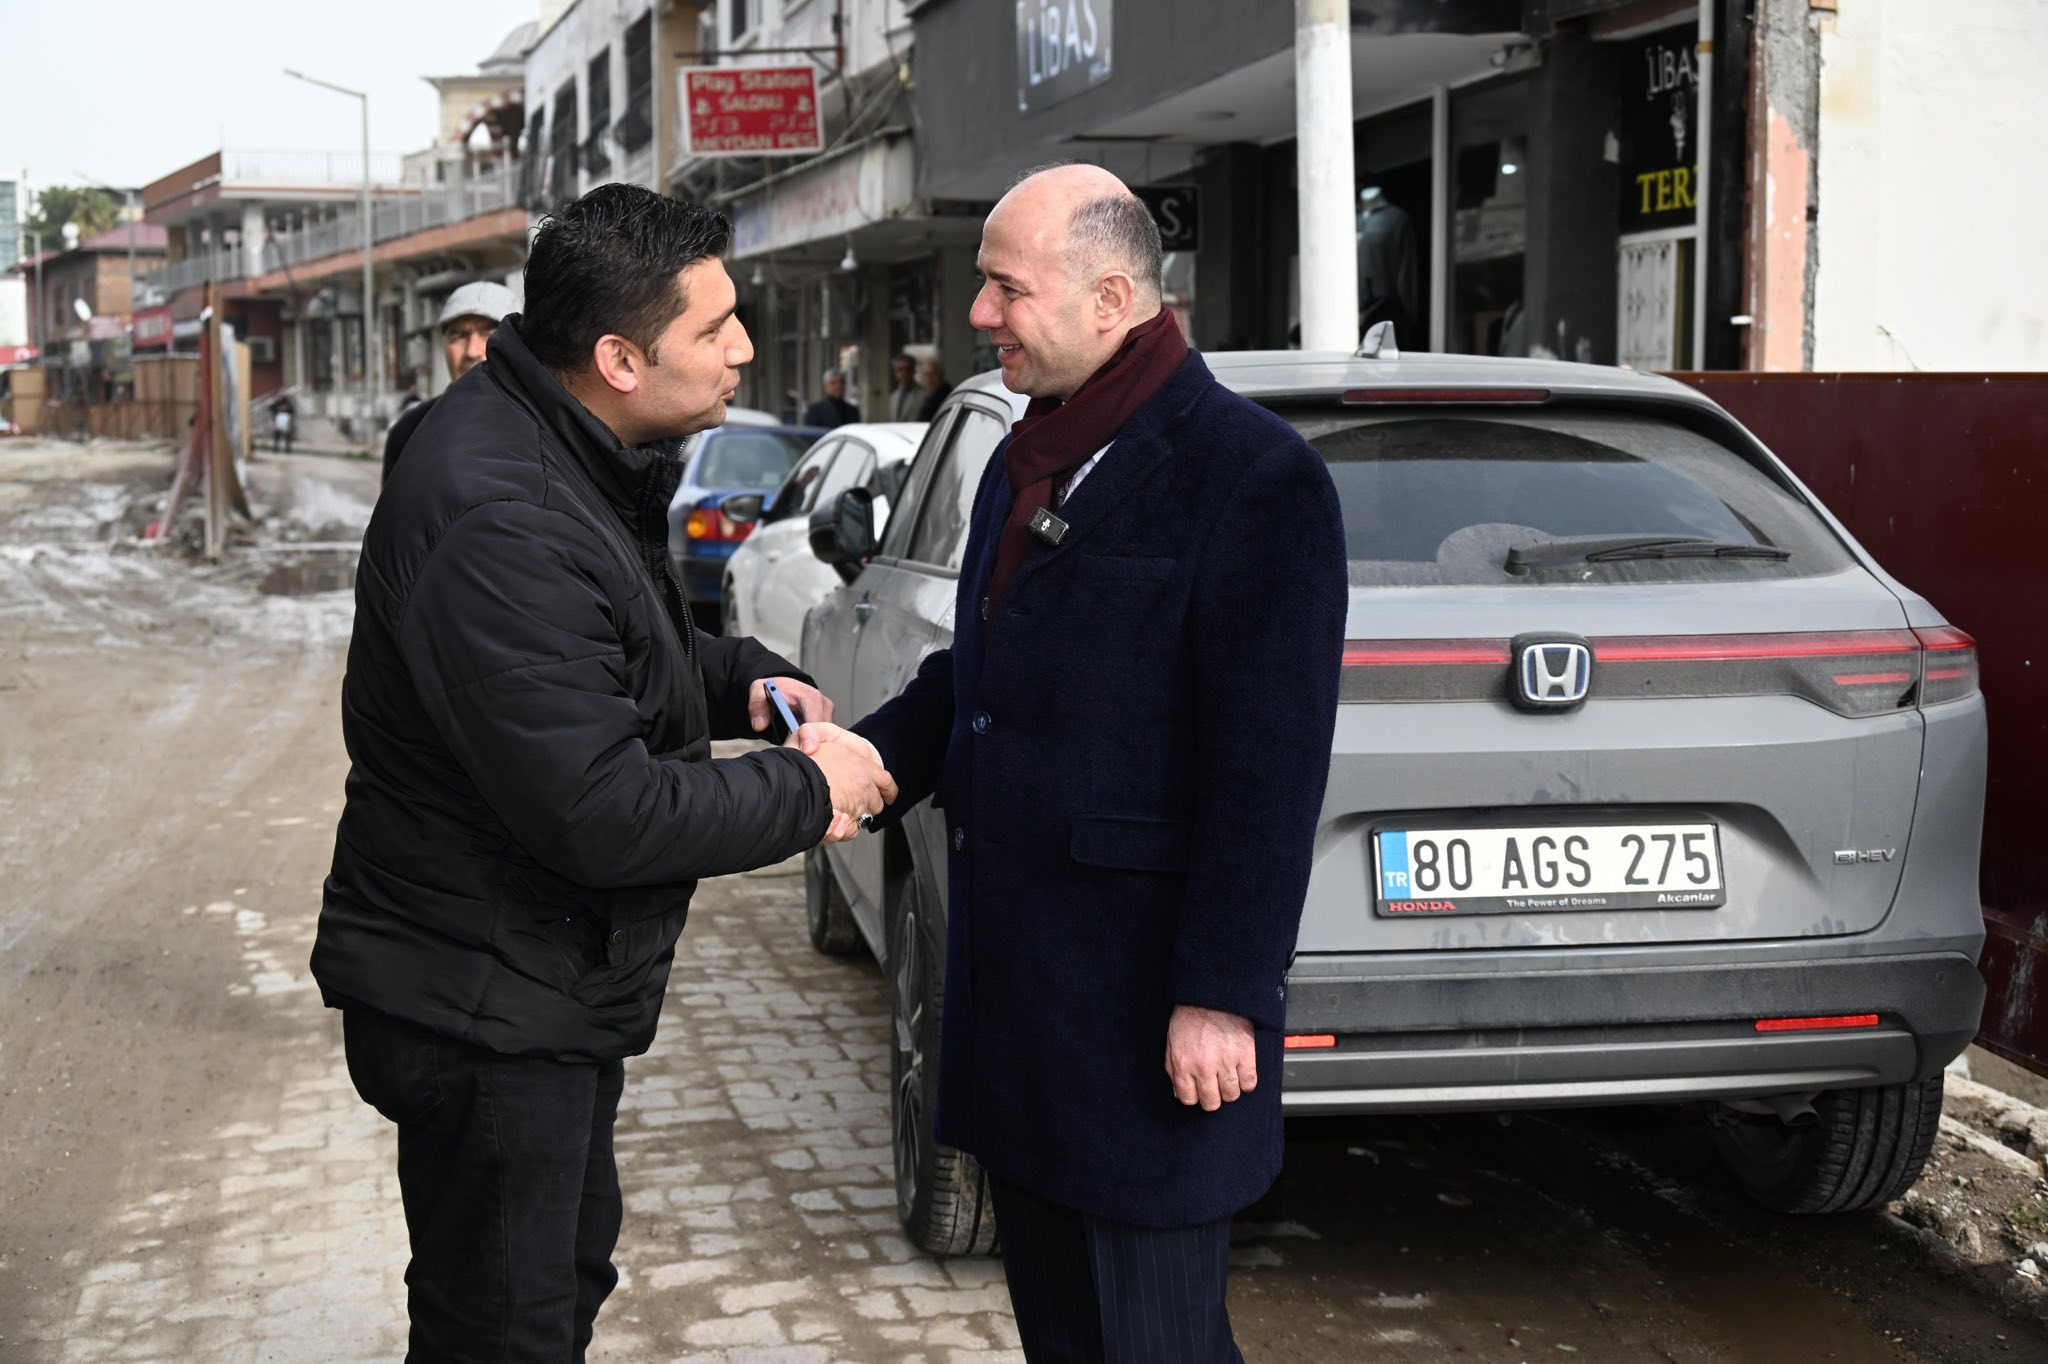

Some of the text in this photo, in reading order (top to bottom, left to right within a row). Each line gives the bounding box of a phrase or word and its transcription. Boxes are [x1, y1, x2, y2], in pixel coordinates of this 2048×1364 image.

[692, 69, 810, 94] Play Station
[1413, 833, 1712, 892] 80 AGS 275
[1385, 871, 1408, 888] TR
[1507, 897, 1607, 908] The Power of Dreams
[1657, 893, 1717, 904] Akcanlar
[1388, 901, 1456, 912] HONDA
